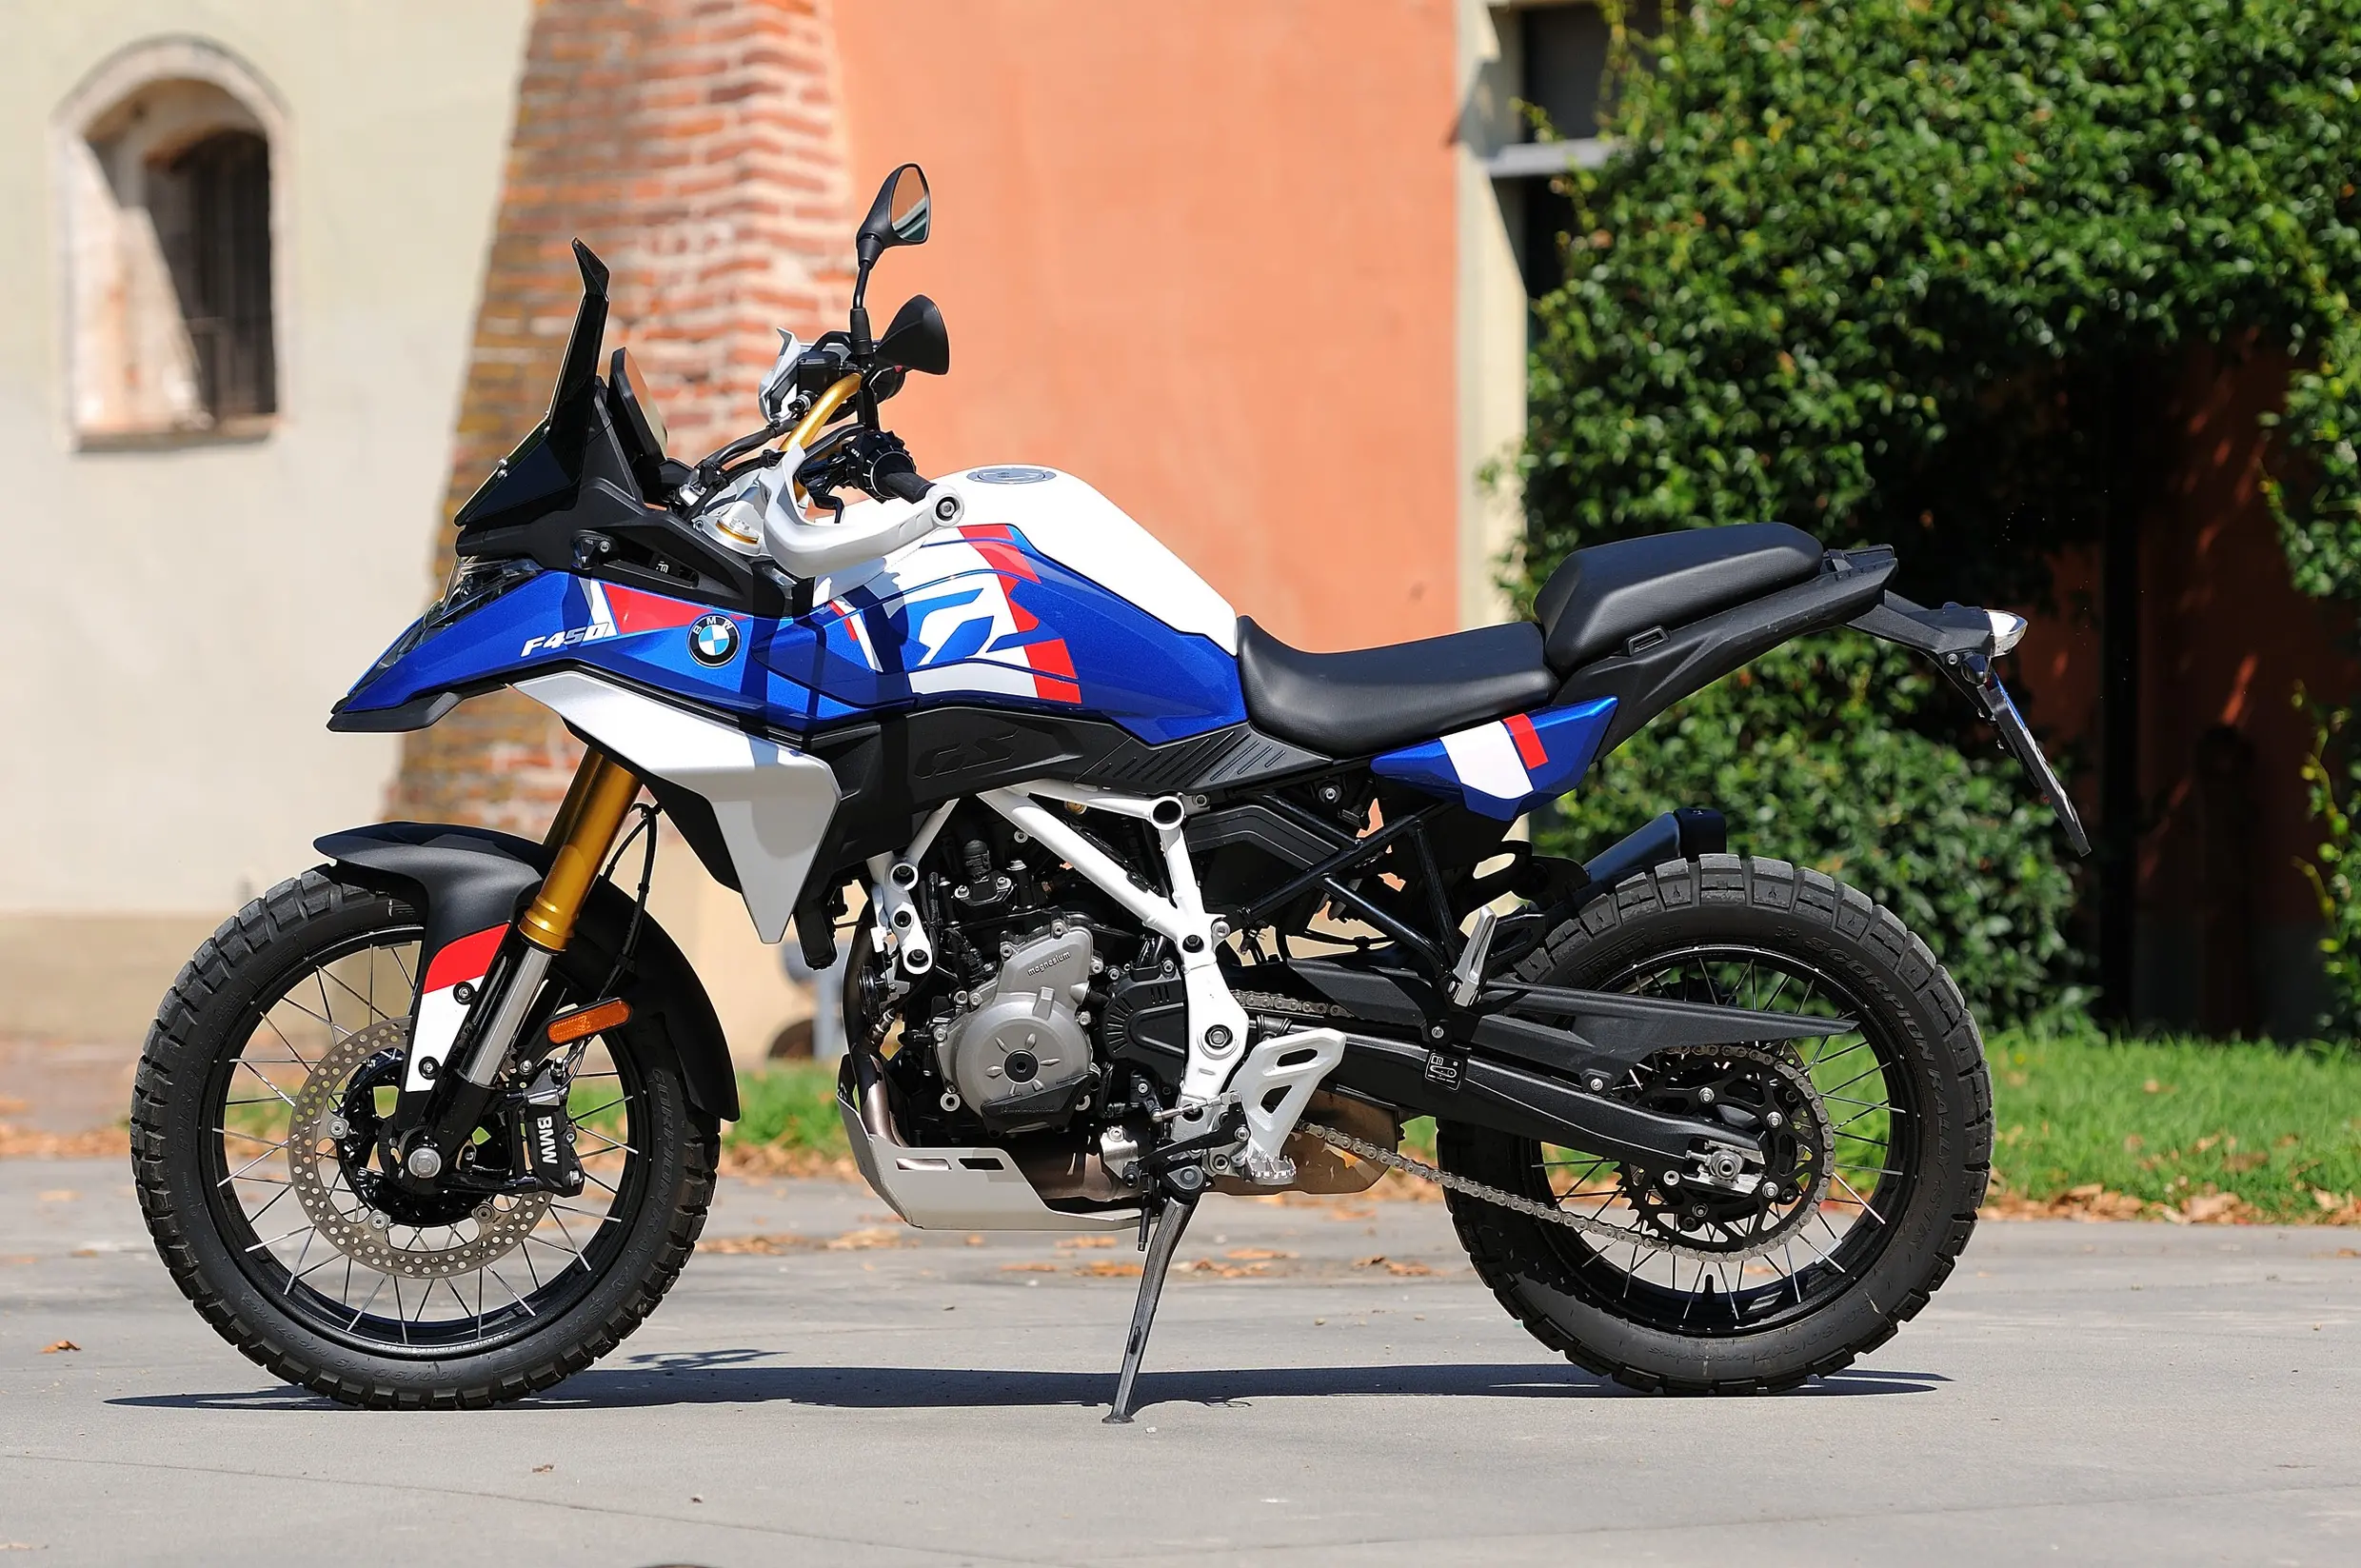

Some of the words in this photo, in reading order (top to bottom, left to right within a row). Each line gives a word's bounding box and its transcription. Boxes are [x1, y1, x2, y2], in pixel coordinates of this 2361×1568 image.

[521, 622, 609, 657] F450
[692, 616, 734, 635] BMW
[1027, 951, 1071, 977] magnesium
[1804, 937, 1935, 1062] SCORPION
[1927, 1067, 1951, 1179] RALLY
[537, 1116, 558, 1164] BMW
[652, 1068, 674, 1207] CORPION
